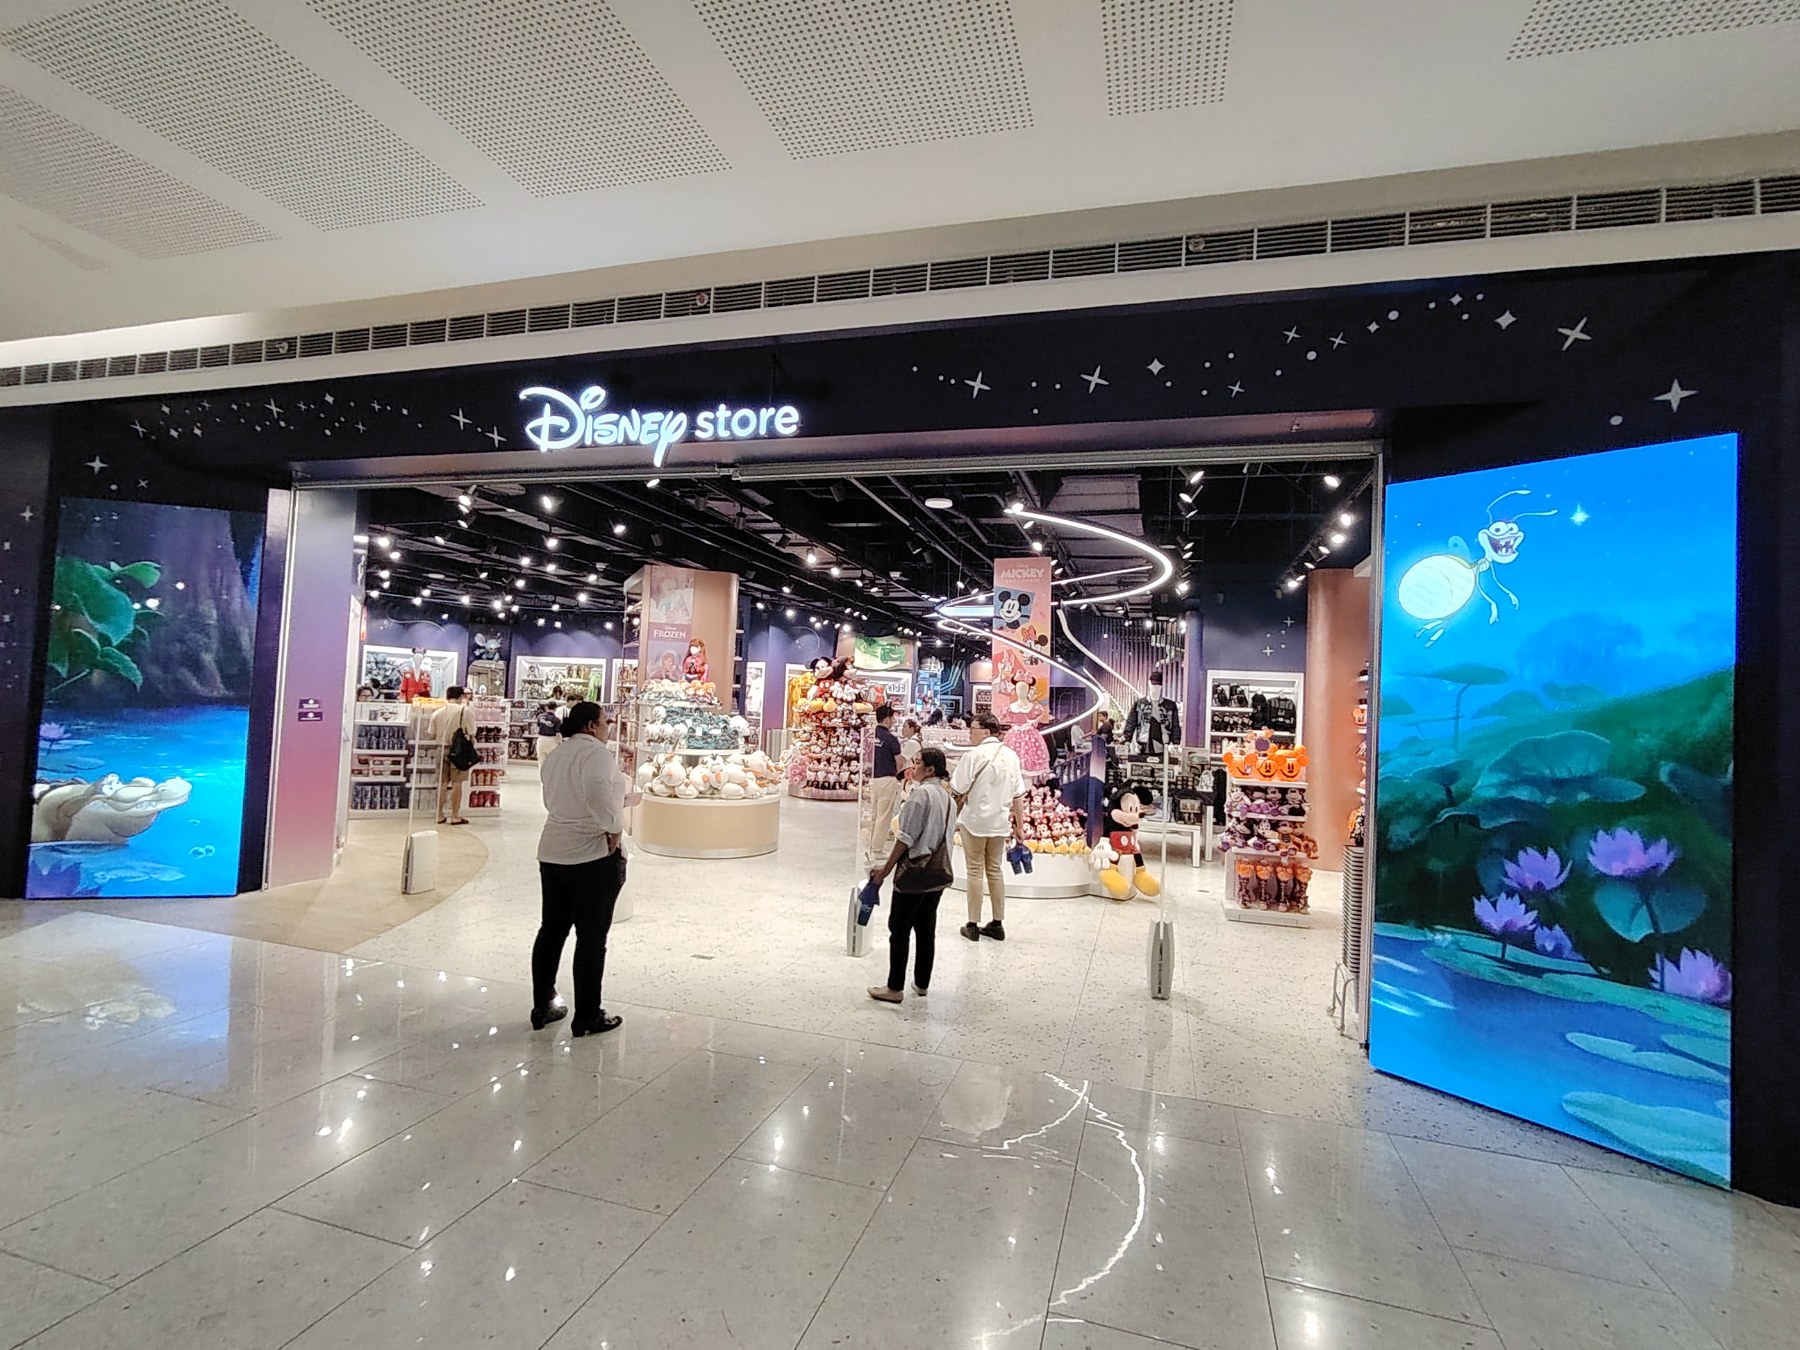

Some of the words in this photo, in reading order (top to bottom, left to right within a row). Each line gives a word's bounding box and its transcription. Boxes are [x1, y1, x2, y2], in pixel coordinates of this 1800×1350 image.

[694, 403, 799, 439] store
[1000, 567, 1045, 579] MICKEY
[653, 629, 686, 639] FROZEN
